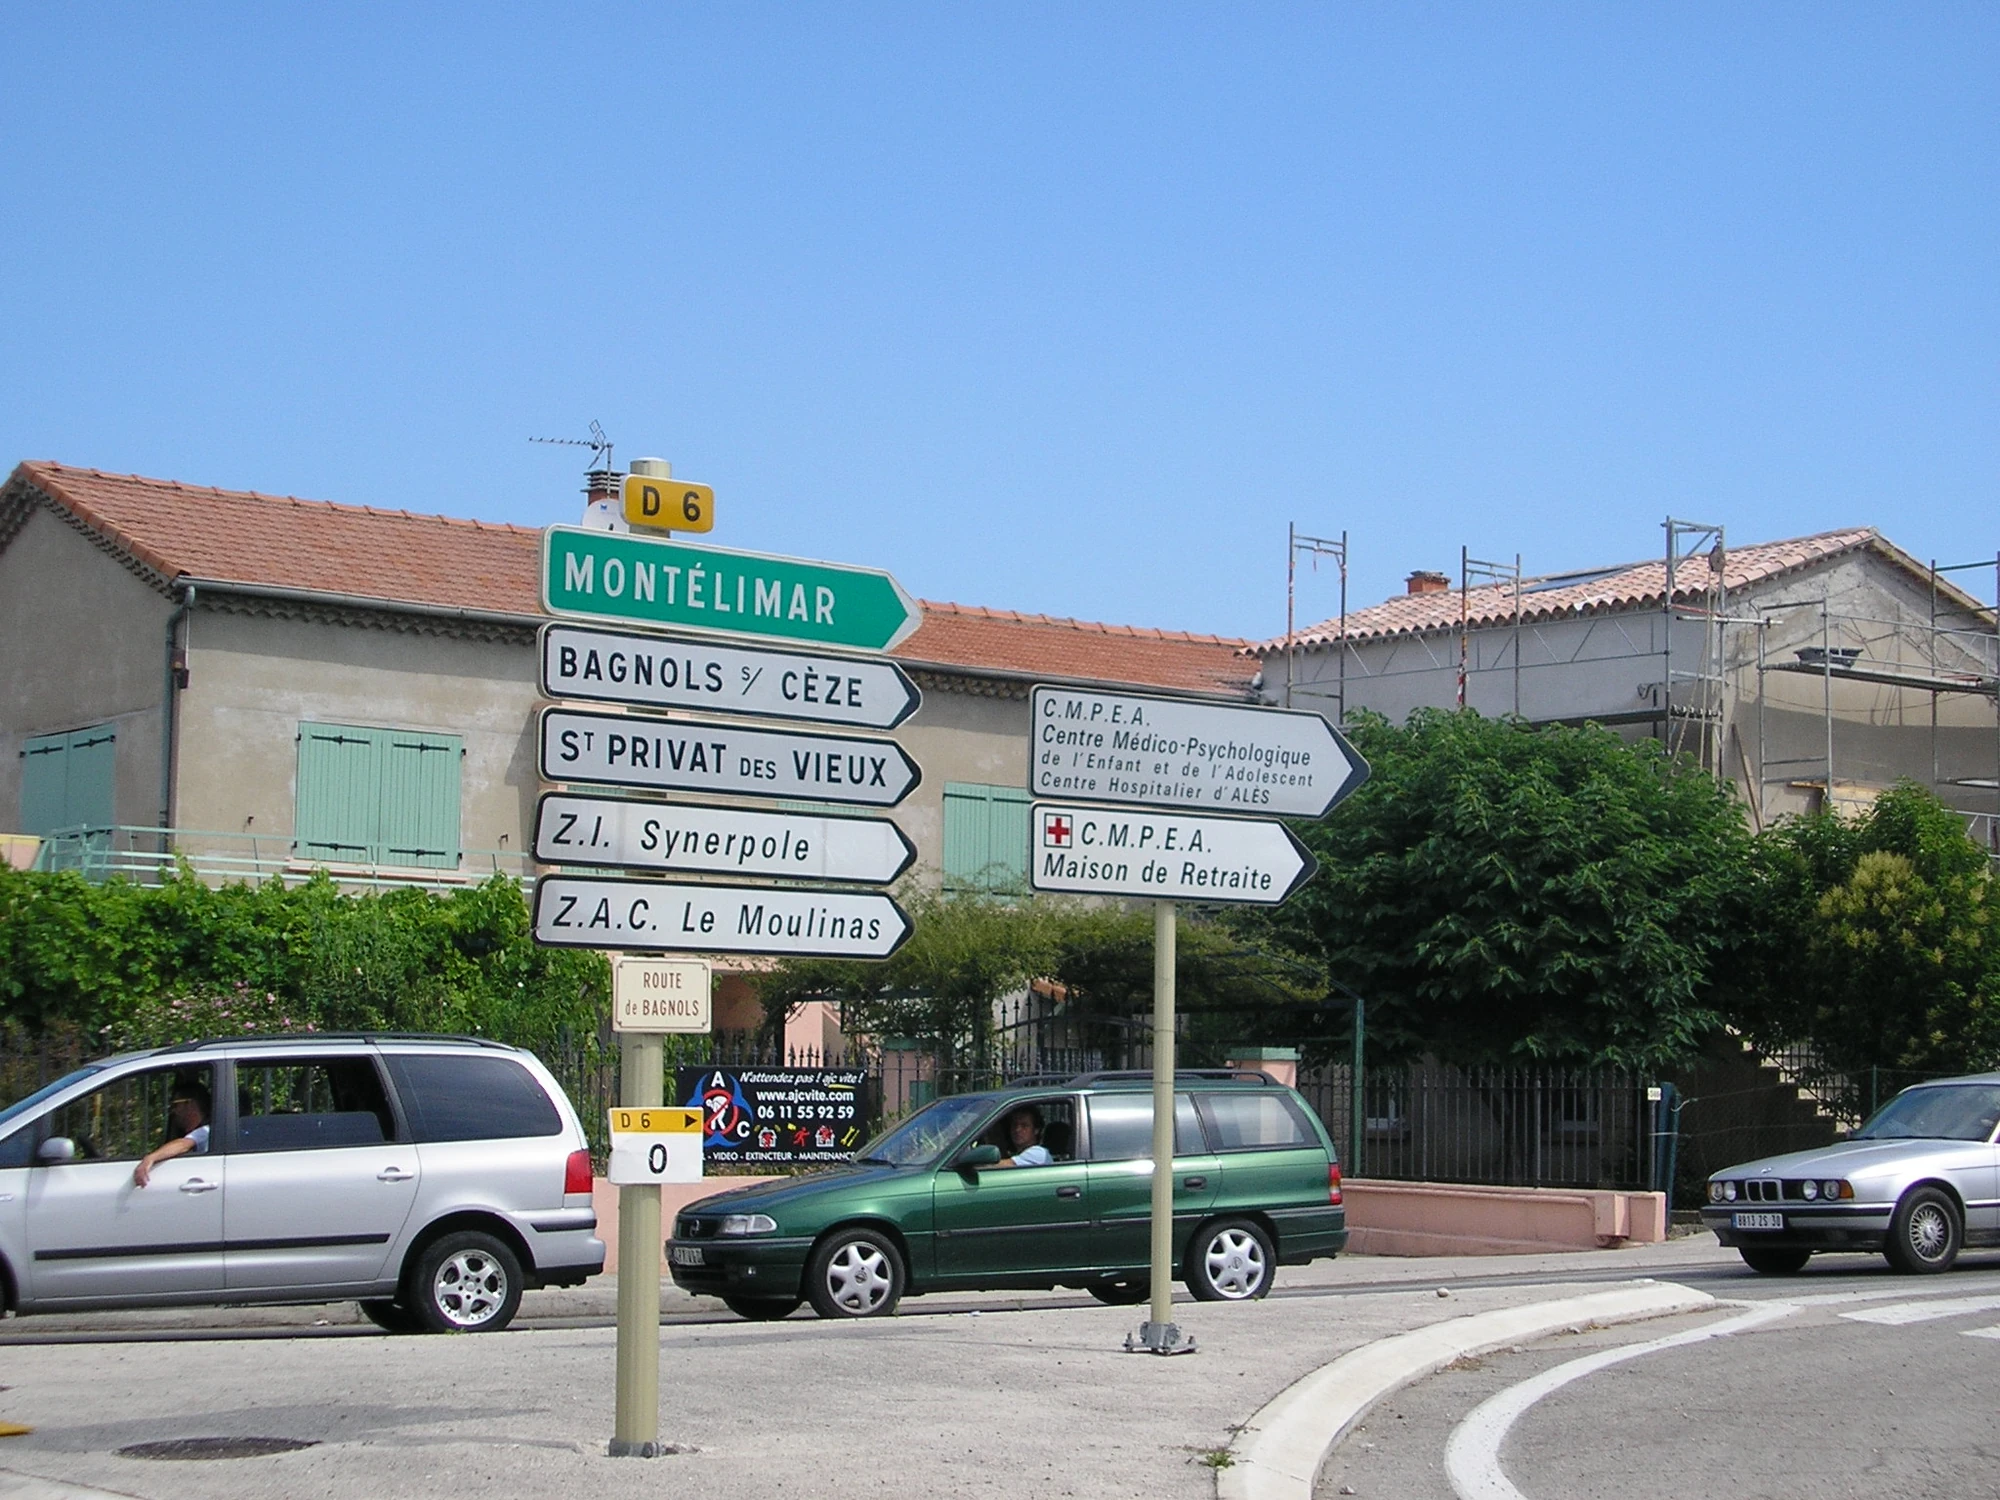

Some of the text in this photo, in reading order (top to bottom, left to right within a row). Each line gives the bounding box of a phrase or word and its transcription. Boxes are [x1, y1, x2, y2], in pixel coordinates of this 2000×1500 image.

[642, 485, 701, 522] D 6
[564, 551, 836, 626] MONTÉLIMAR
[560, 646, 723, 692] BAGNOLS
[781, 666, 863, 707] CÈZE
[1043, 698, 1151, 727] C.M.P.E.A.
[1042, 724, 1311, 767] Centre Médico-Psychologique
[608, 734, 727, 774] PRIVAT
[740, 758, 777, 780] DES
[793, 750, 887, 787] VIEUX
[1041, 749, 1313, 787] de l'Enfant et de l'Adolescent
[1041, 772, 1096, 790] Centre
[1109, 778, 1202, 799] Hospitalier
[552, 813, 810, 865] Z.I. Synerpole
[1081, 821, 1211, 854] C.M.P.E.A.
[1043, 852, 1271, 890] Maison de Retraite
[552, 895, 881, 941] Z.A.C. Le Moulinas
[643, 971, 682, 989] ROUTE
[625, 999, 699, 1016] de BAGNOLS
[711, 1071, 725, 1087] A
[795, 1075, 814, 1086] pas
[822, 1074, 837, 1087] ajc
[839, 1073, 857, 1083] vite
[756, 1089, 854, 1104] www.ajcvite.com
[621, 1113, 651, 1128] D 6
[757, 1106, 855, 1119] 06 11 55 92 59
[737, 1121, 750, 1138] C
[713, 1151, 739, 1161] VIDEO
[745, 1151, 793, 1161] EXTINCTEUR
